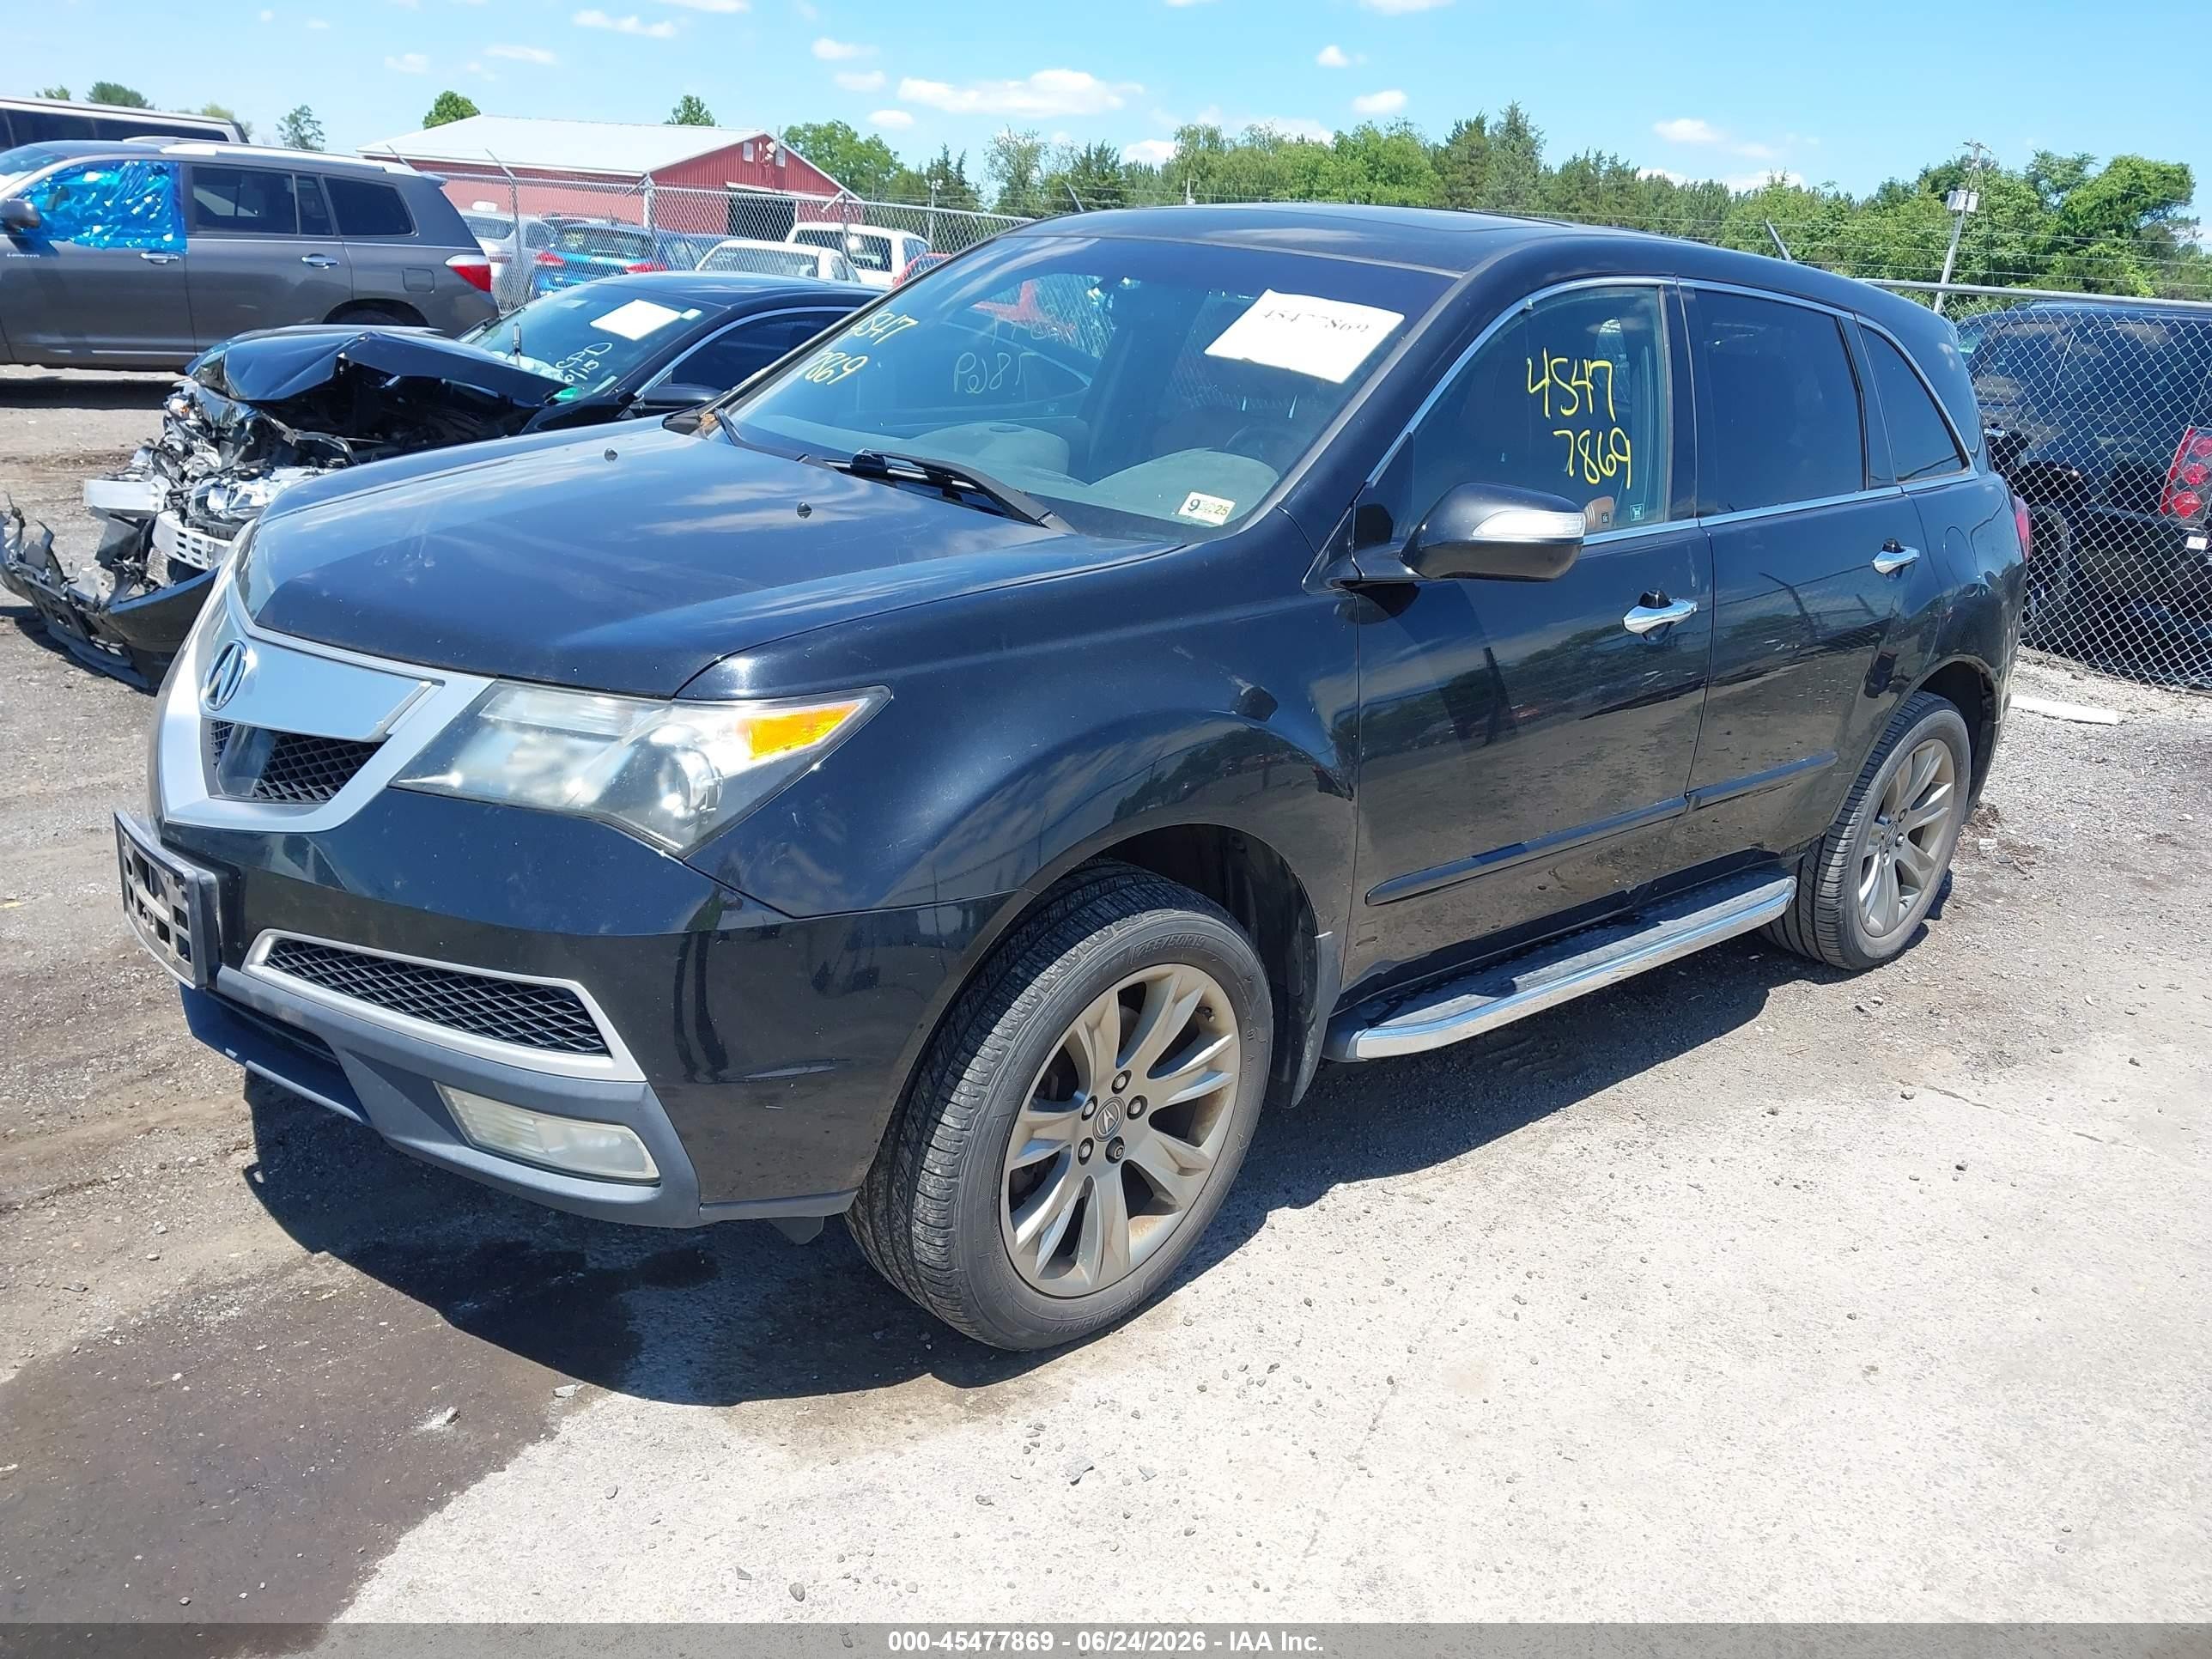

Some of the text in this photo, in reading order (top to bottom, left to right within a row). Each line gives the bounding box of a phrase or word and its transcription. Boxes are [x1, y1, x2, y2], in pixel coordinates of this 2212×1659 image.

[1527, 347, 1616, 422] 4547
[1553, 427, 1632, 490] 7869
[1188, 498, 1202, 513] 9
[1213, 504, 1231, 516] 25
